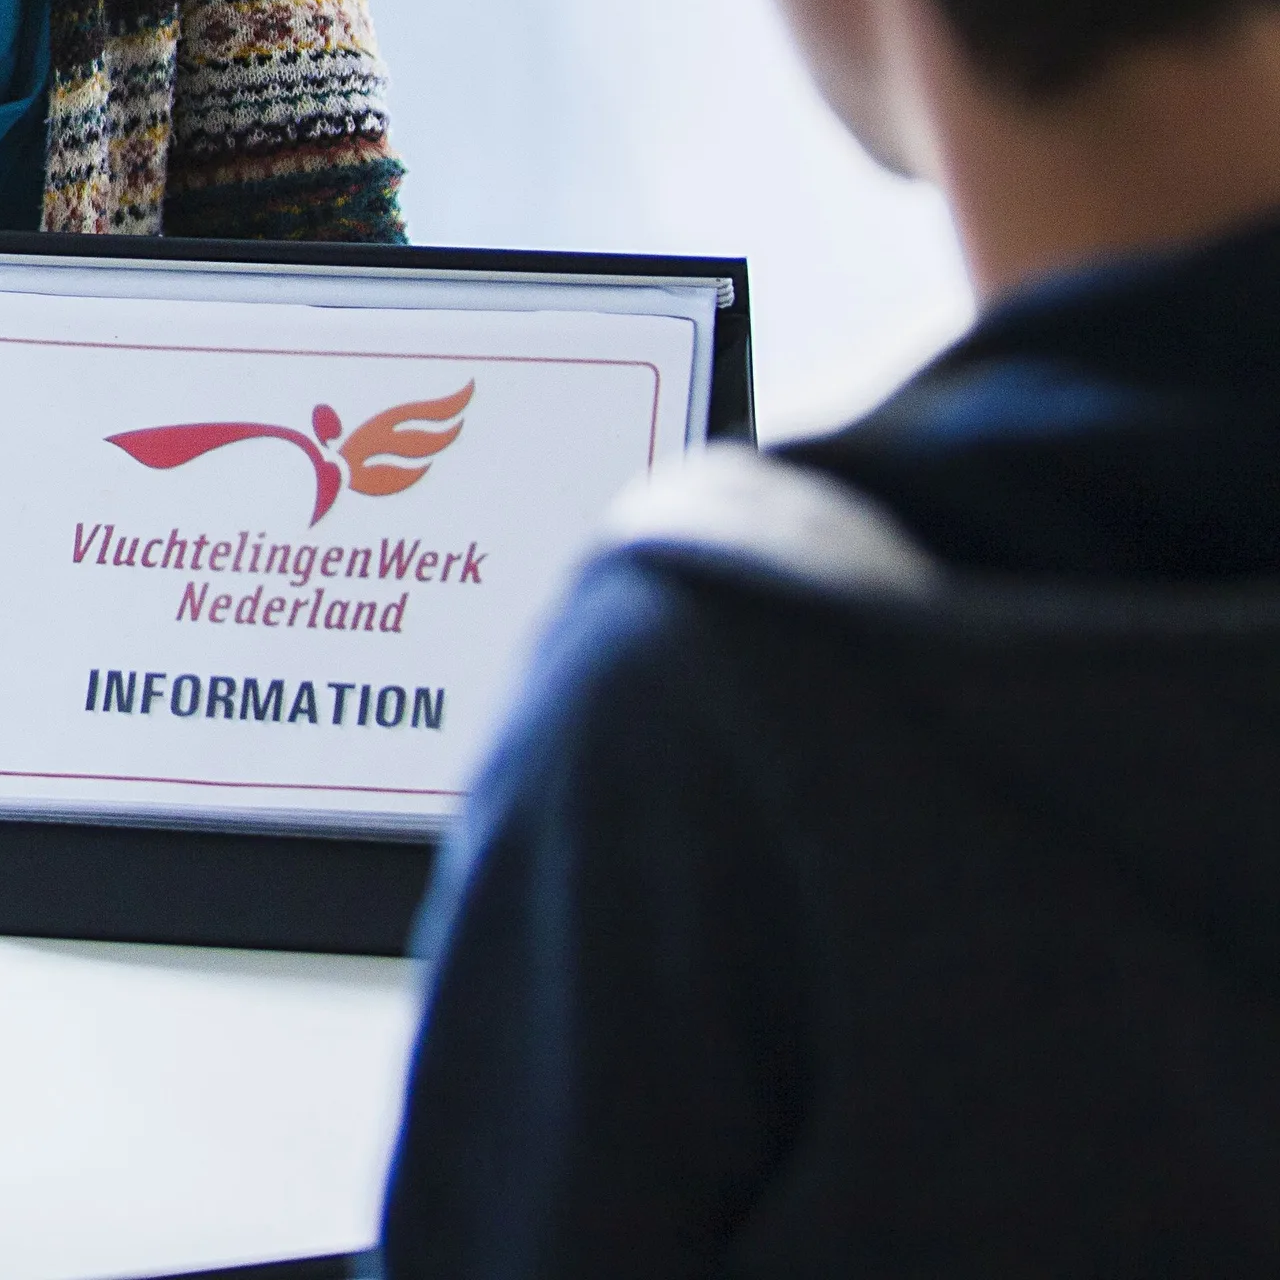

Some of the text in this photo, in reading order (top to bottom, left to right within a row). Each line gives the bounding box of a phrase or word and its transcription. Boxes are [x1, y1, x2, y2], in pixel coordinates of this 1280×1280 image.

[71, 522, 489, 587] VluchtelingenWerk
[175, 581, 410, 634] Nederland
[84, 668, 446, 731] INFORMATION
